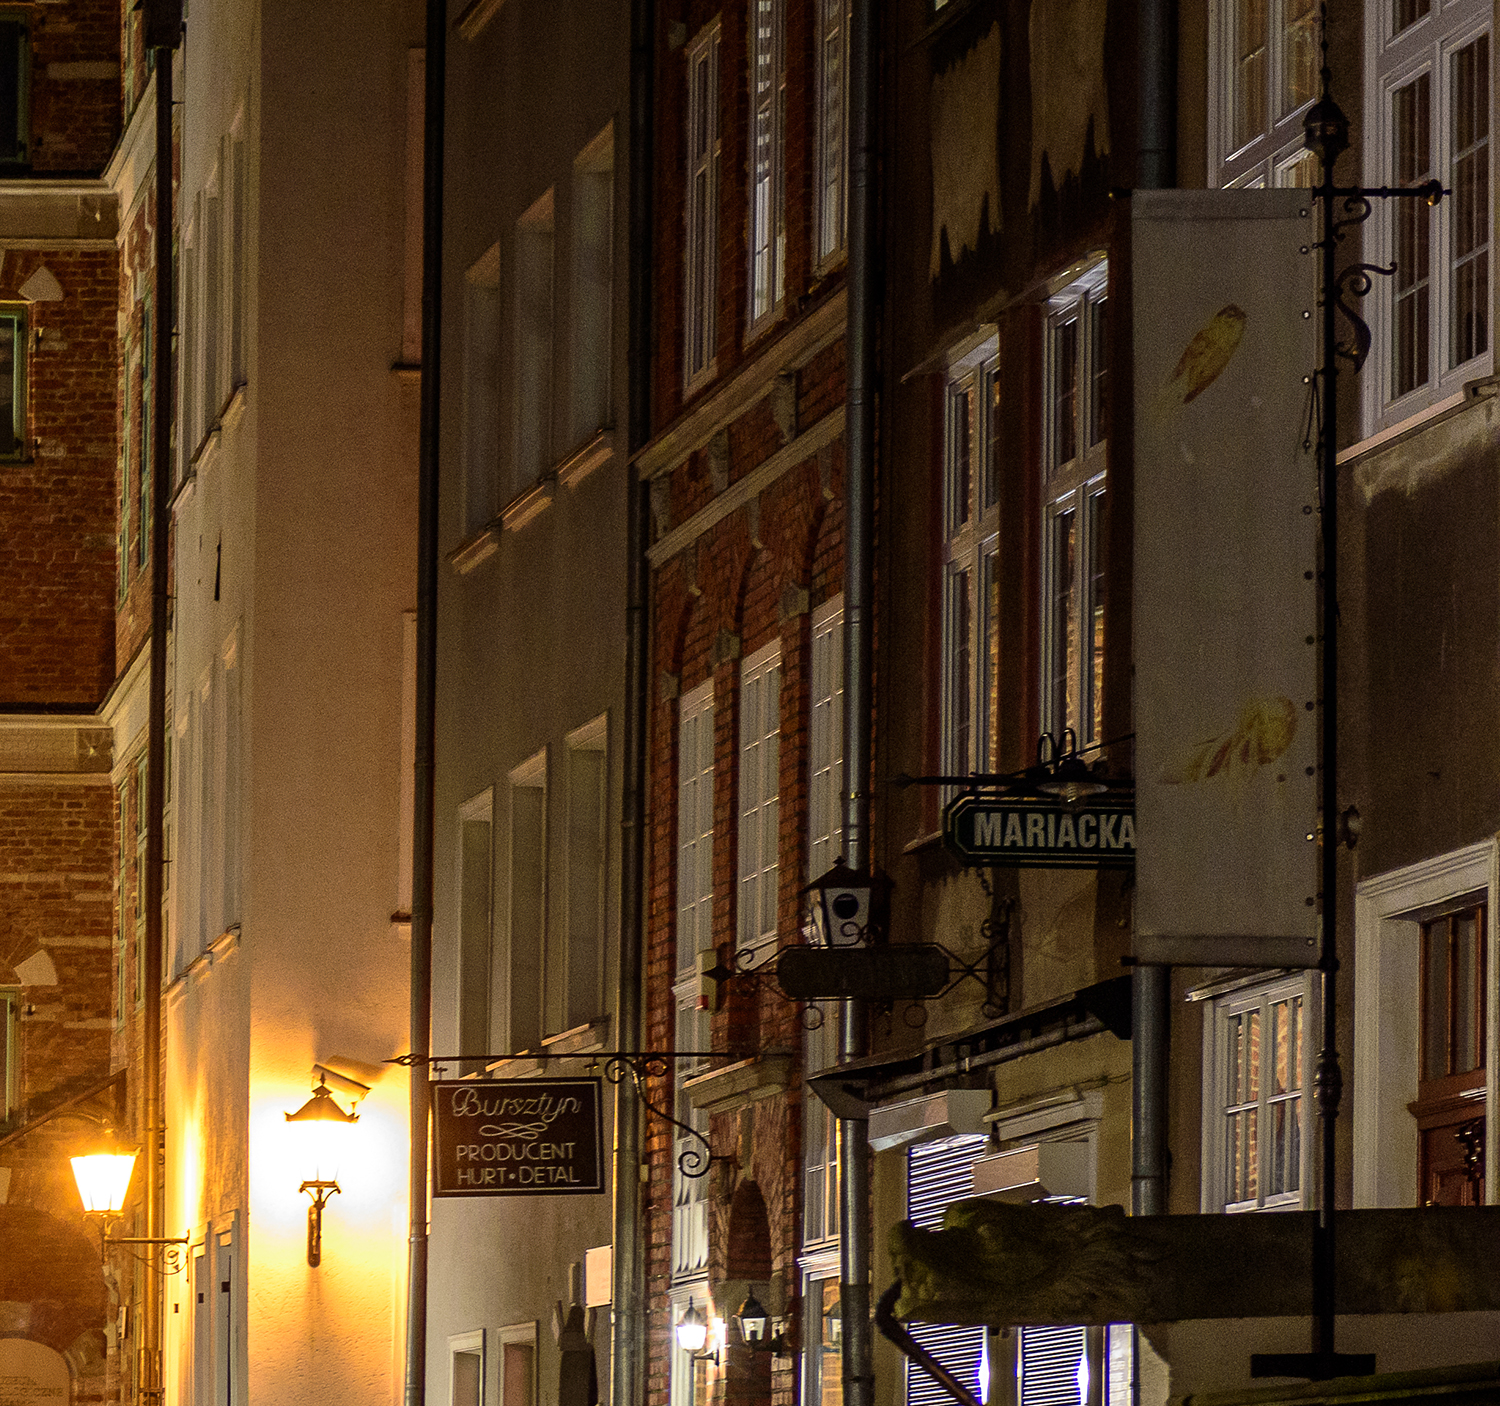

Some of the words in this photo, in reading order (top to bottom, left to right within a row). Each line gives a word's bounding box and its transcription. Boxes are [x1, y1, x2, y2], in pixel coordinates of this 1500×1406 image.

[973, 812, 1136, 849] MARIACKA
[452, 1087, 582, 1123] Bursztyn
[456, 1142, 576, 1162] PRODUCENT
[457, 1167, 507, 1185] HURT
[518, 1166, 582, 1184] DETAL
